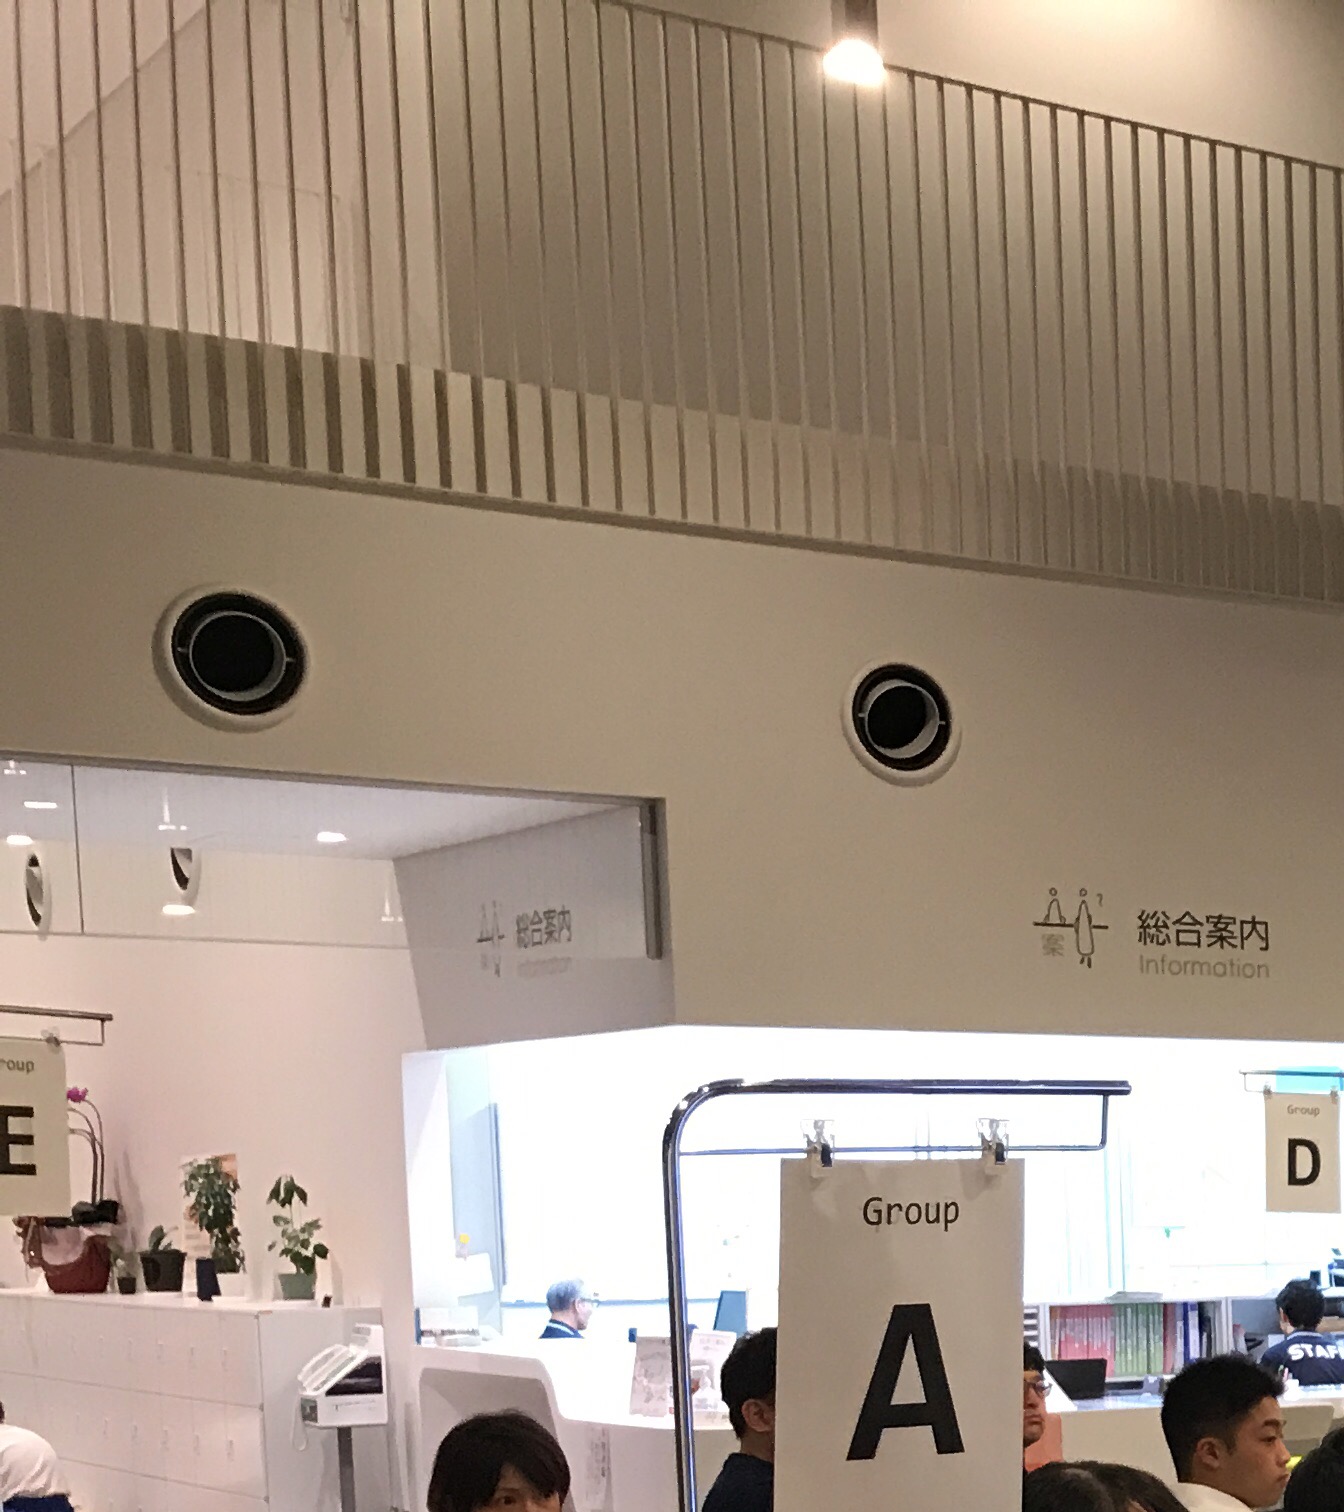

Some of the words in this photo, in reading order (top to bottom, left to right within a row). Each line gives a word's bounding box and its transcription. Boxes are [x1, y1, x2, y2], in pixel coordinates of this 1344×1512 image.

[1137, 909, 1270, 951] 総合案内
[1139, 954, 1270, 979] Information
[1286, 1104, 1321, 1118] Group
[0, 1104, 37, 1176] E
[1287, 1137, 1322, 1186] D
[862, 1196, 960, 1232] Group
[846, 1303, 965, 1461] A
